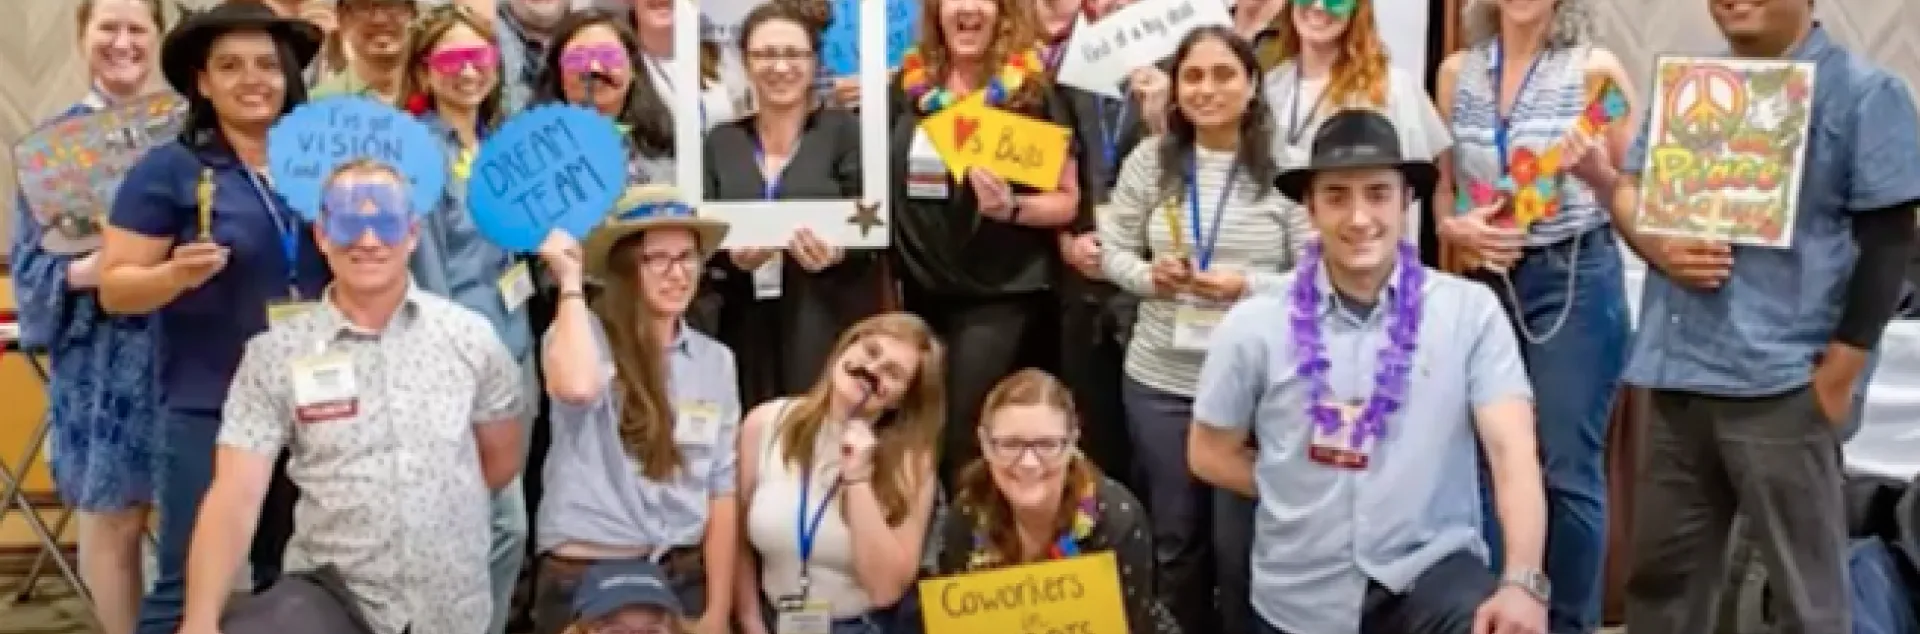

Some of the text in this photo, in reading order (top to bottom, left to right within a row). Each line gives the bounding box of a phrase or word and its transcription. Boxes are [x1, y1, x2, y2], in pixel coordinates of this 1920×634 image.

[298, 131, 403, 161] VISION
[481, 116, 581, 199] DREAM
[510, 154, 609, 229] TEAM
[941, 573, 1085, 617] Coworkers
